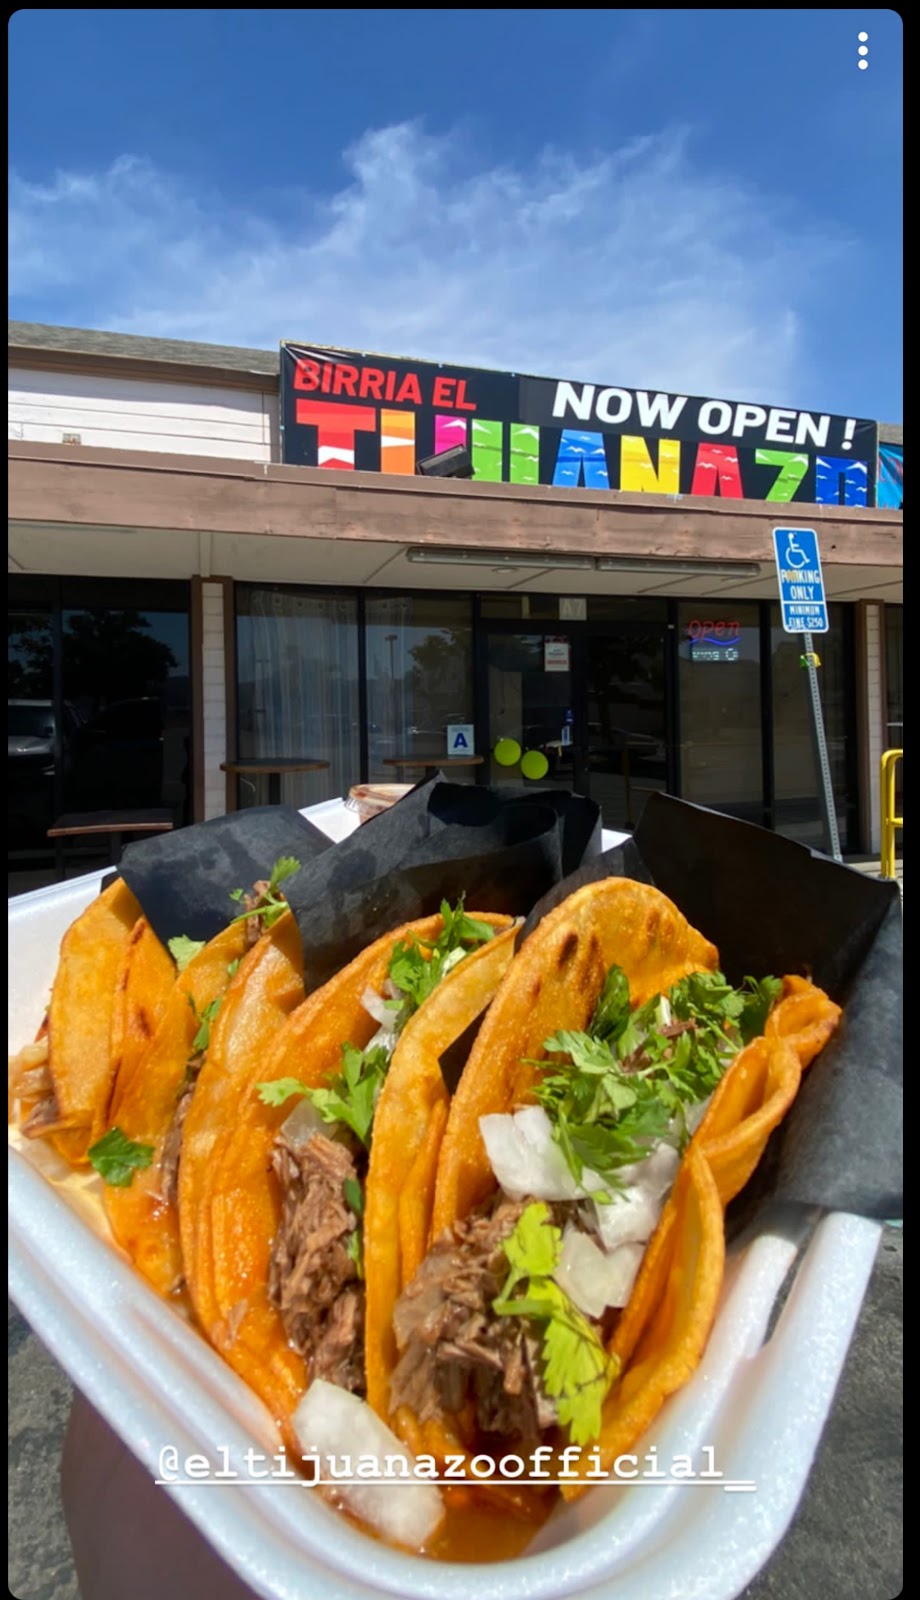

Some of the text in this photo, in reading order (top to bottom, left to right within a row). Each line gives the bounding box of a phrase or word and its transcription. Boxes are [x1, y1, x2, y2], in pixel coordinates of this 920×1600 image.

[293, 358, 477, 411] BIRRIA EL
[552, 381, 688, 431] NOW
[697, 400, 831, 447] OPEN
[790, 586, 814, 600] ONLY
[789, 605, 820, 616] MINIMUM
[788, 617, 804, 627] FINE
[453, 732, 468, 748] A
